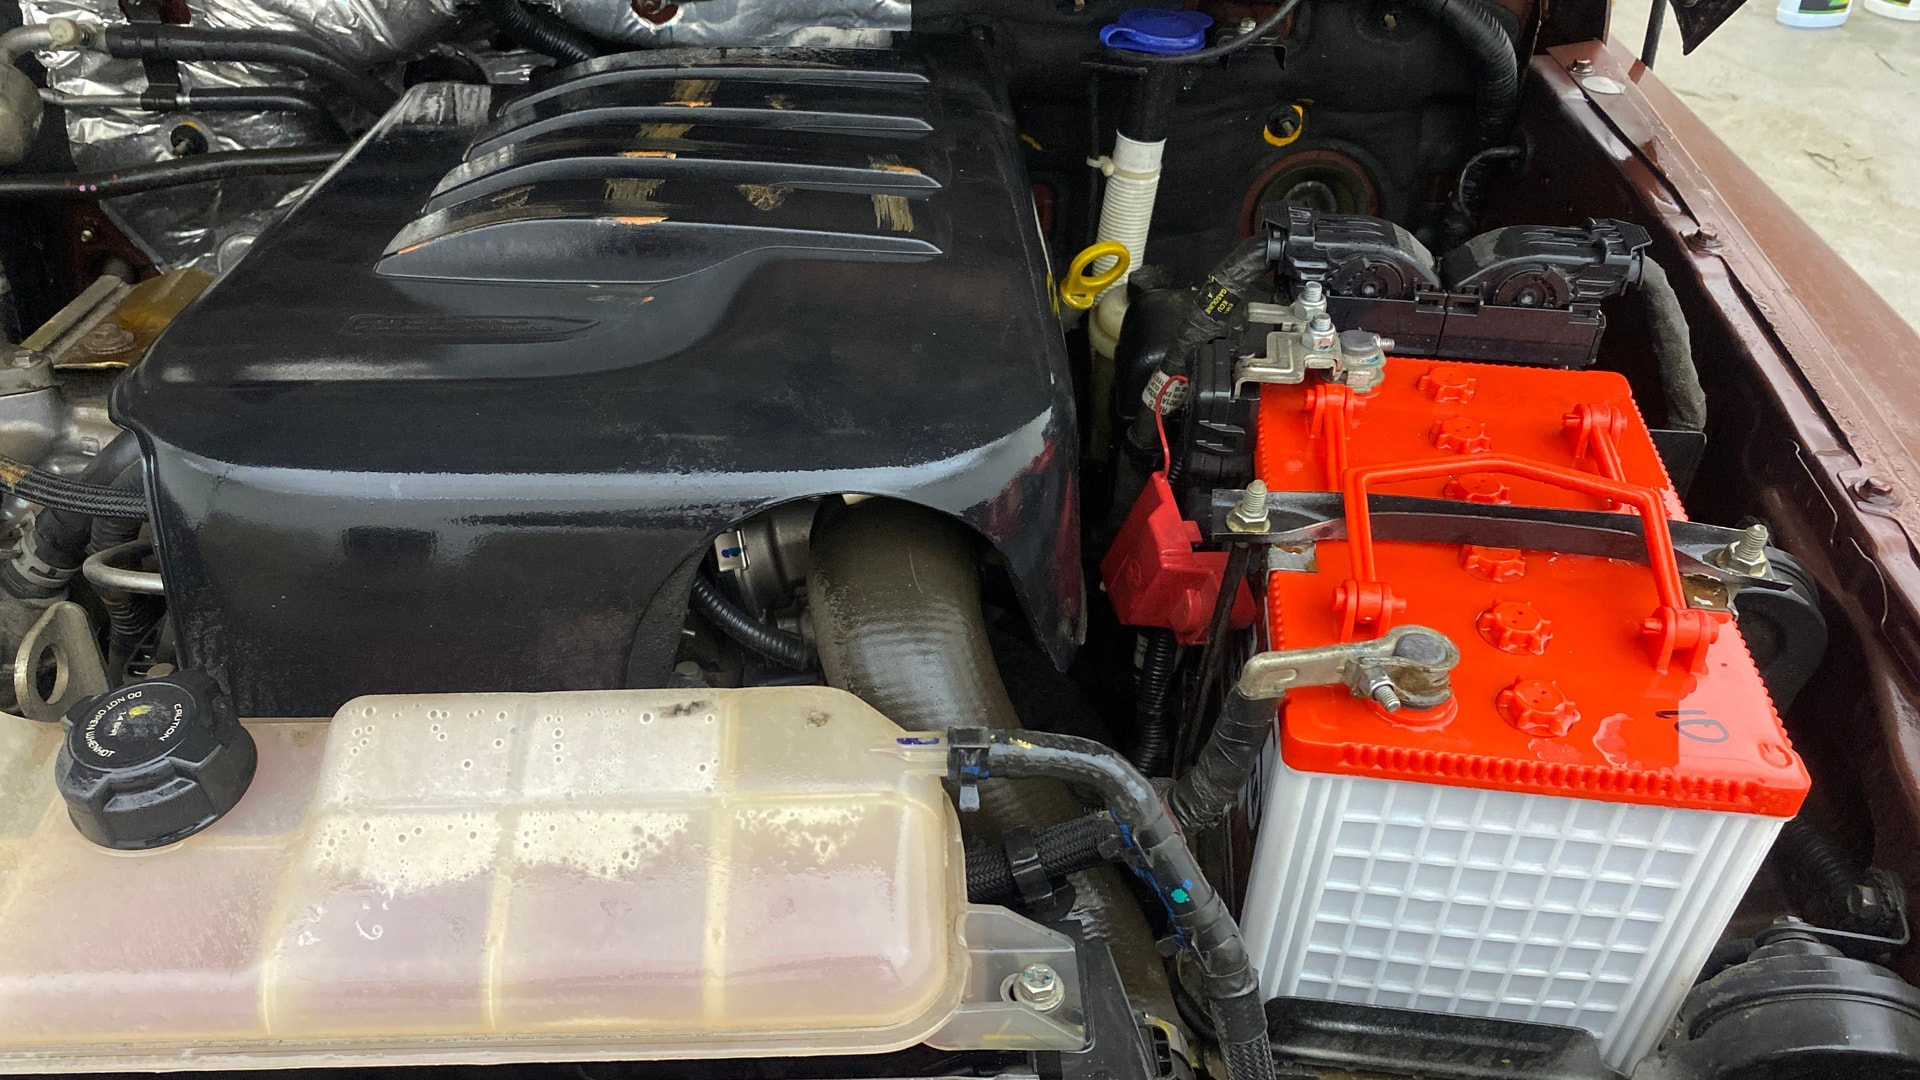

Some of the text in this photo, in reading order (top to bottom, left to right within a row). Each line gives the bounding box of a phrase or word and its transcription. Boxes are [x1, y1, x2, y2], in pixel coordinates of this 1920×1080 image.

[1204, 288, 1227, 315] GASOLINE
[1217, 300, 1229, 313] ECU
[106, 696, 126, 711] NOT
[127, 691, 142, 700] DO
[86, 709, 107, 730] OPEN
[159, 703, 183, 741] CAUTION
